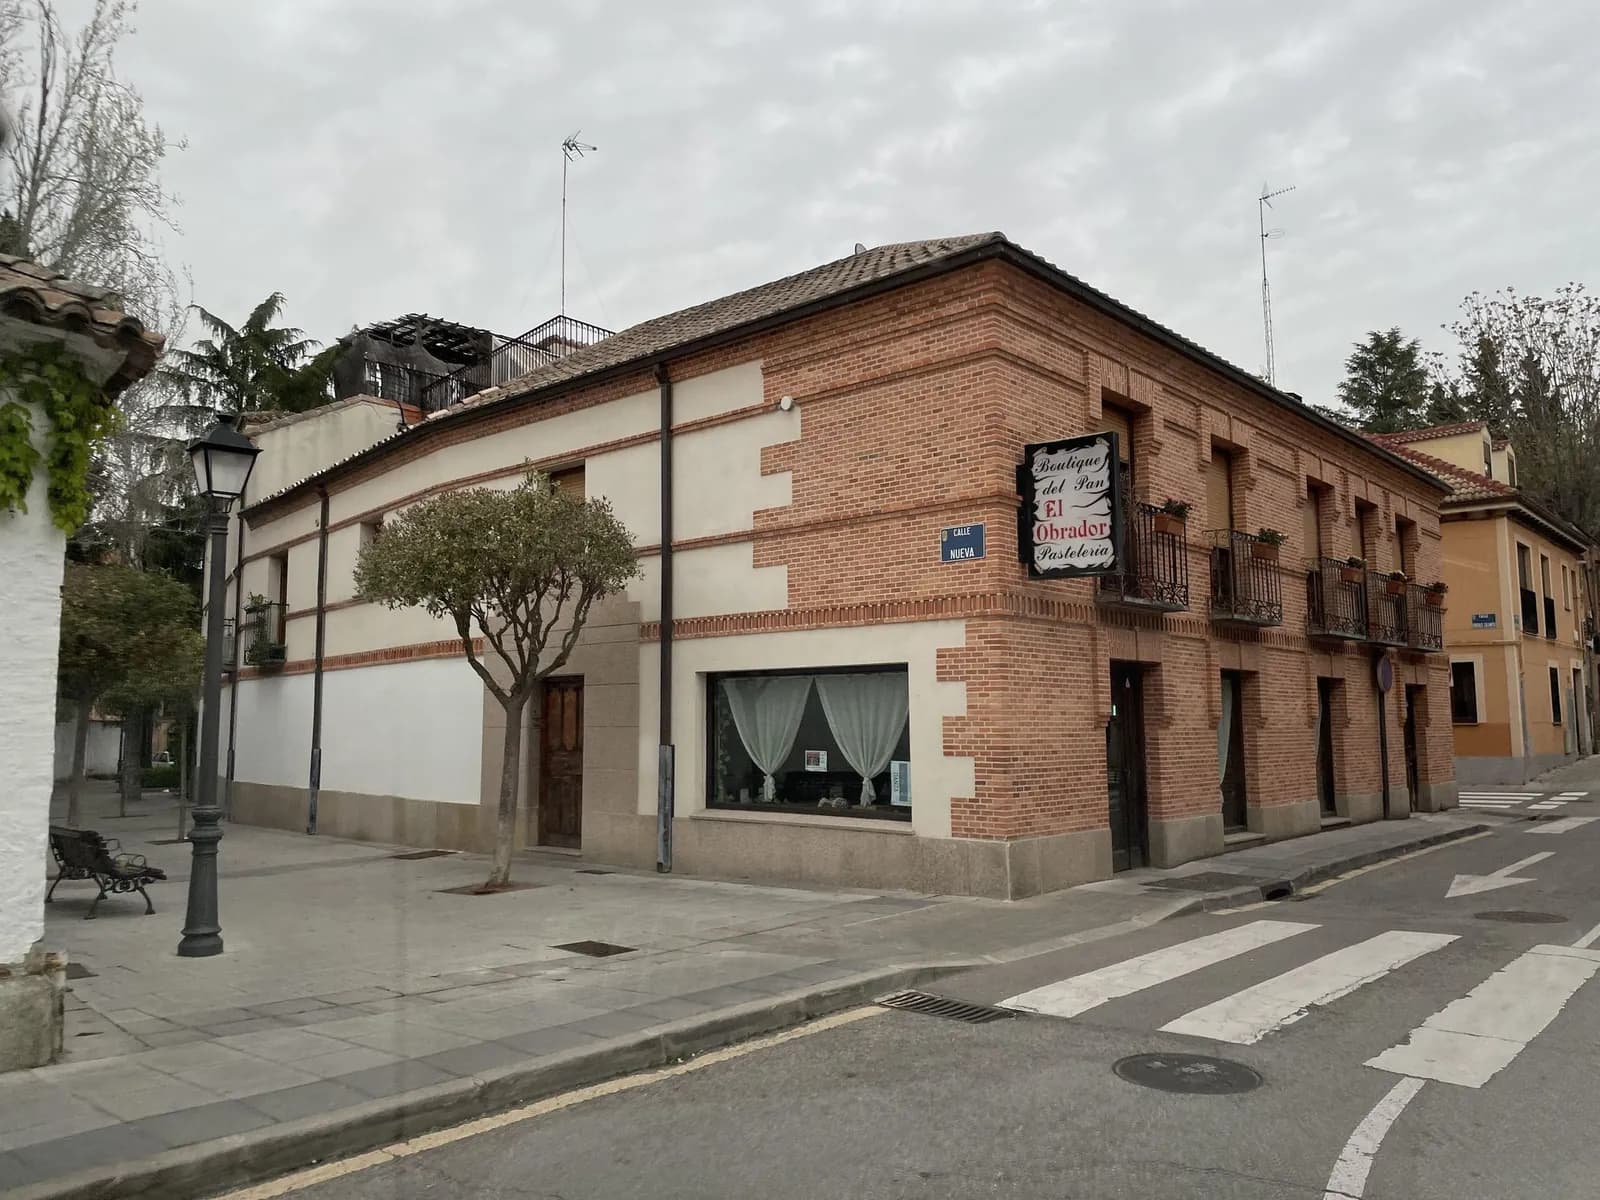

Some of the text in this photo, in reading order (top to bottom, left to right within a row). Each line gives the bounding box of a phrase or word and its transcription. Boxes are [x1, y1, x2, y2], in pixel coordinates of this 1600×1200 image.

[1035, 456, 1099, 473] Boutique
[1042, 475, 1104, 495] del Pan
[1044, 500, 1063, 518] El
[953, 527, 971, 537] CALLE
[1036, 520, 1107, 541] Obrador
[950, 547, 975, 559] NUEVA
